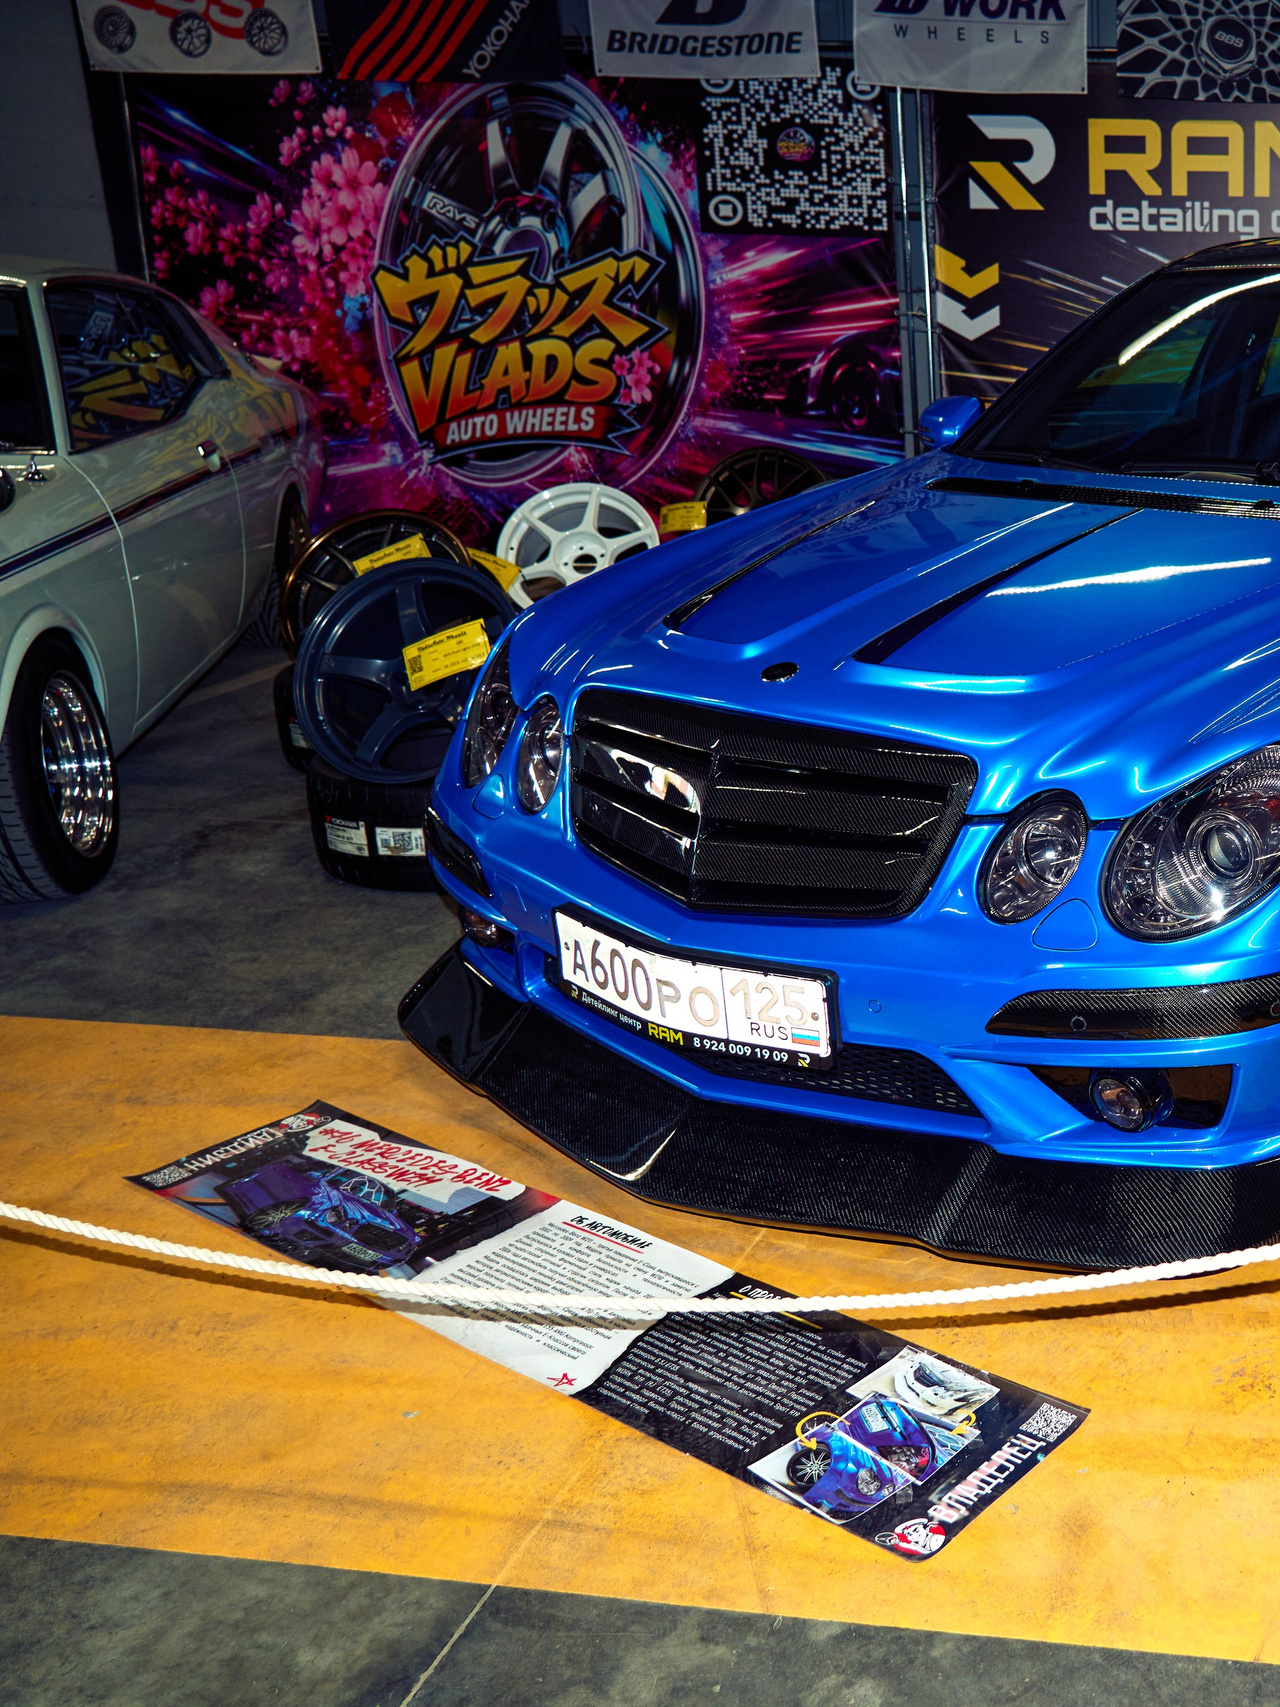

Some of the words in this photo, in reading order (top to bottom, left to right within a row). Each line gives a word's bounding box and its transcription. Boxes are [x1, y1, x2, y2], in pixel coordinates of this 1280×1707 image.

[943, 0, 1067, 21] WORK
[462, 0, 529, 79] YOKOHA
[606, 29, 803, 57] BRIDGESTONE
[894, 24, 1050, 44] WHEELS
[1214, 24, 1244, 48] BBS
[427, 195, 481, 230] RAYS
[1089, 200, 1259, 240] detailing
[400, 338, 617, 434] VLADS
[446, 414, 498, 445] AUTO
[505, 407, 595, 434] WHEELS
[730, 979, 809, 1026] 125
[581, 992, 619, 1018] Детейлинг
[619, 1010, 642, 1031] центр
[648, 1022, 684, 1046] RAM
[693, 1036, 701, 1047] 8
[702, 1038, 726, 1053] 924
[729, 1043, 751, 1057] 009
[754, 1048, 770, 1060] 19
[772, 1051, 788, 1063] 09
[750, 1022, 788, 1040] RUS
[928, 1433, 1046, 1525] ВЛАДЕЛЕЦ
